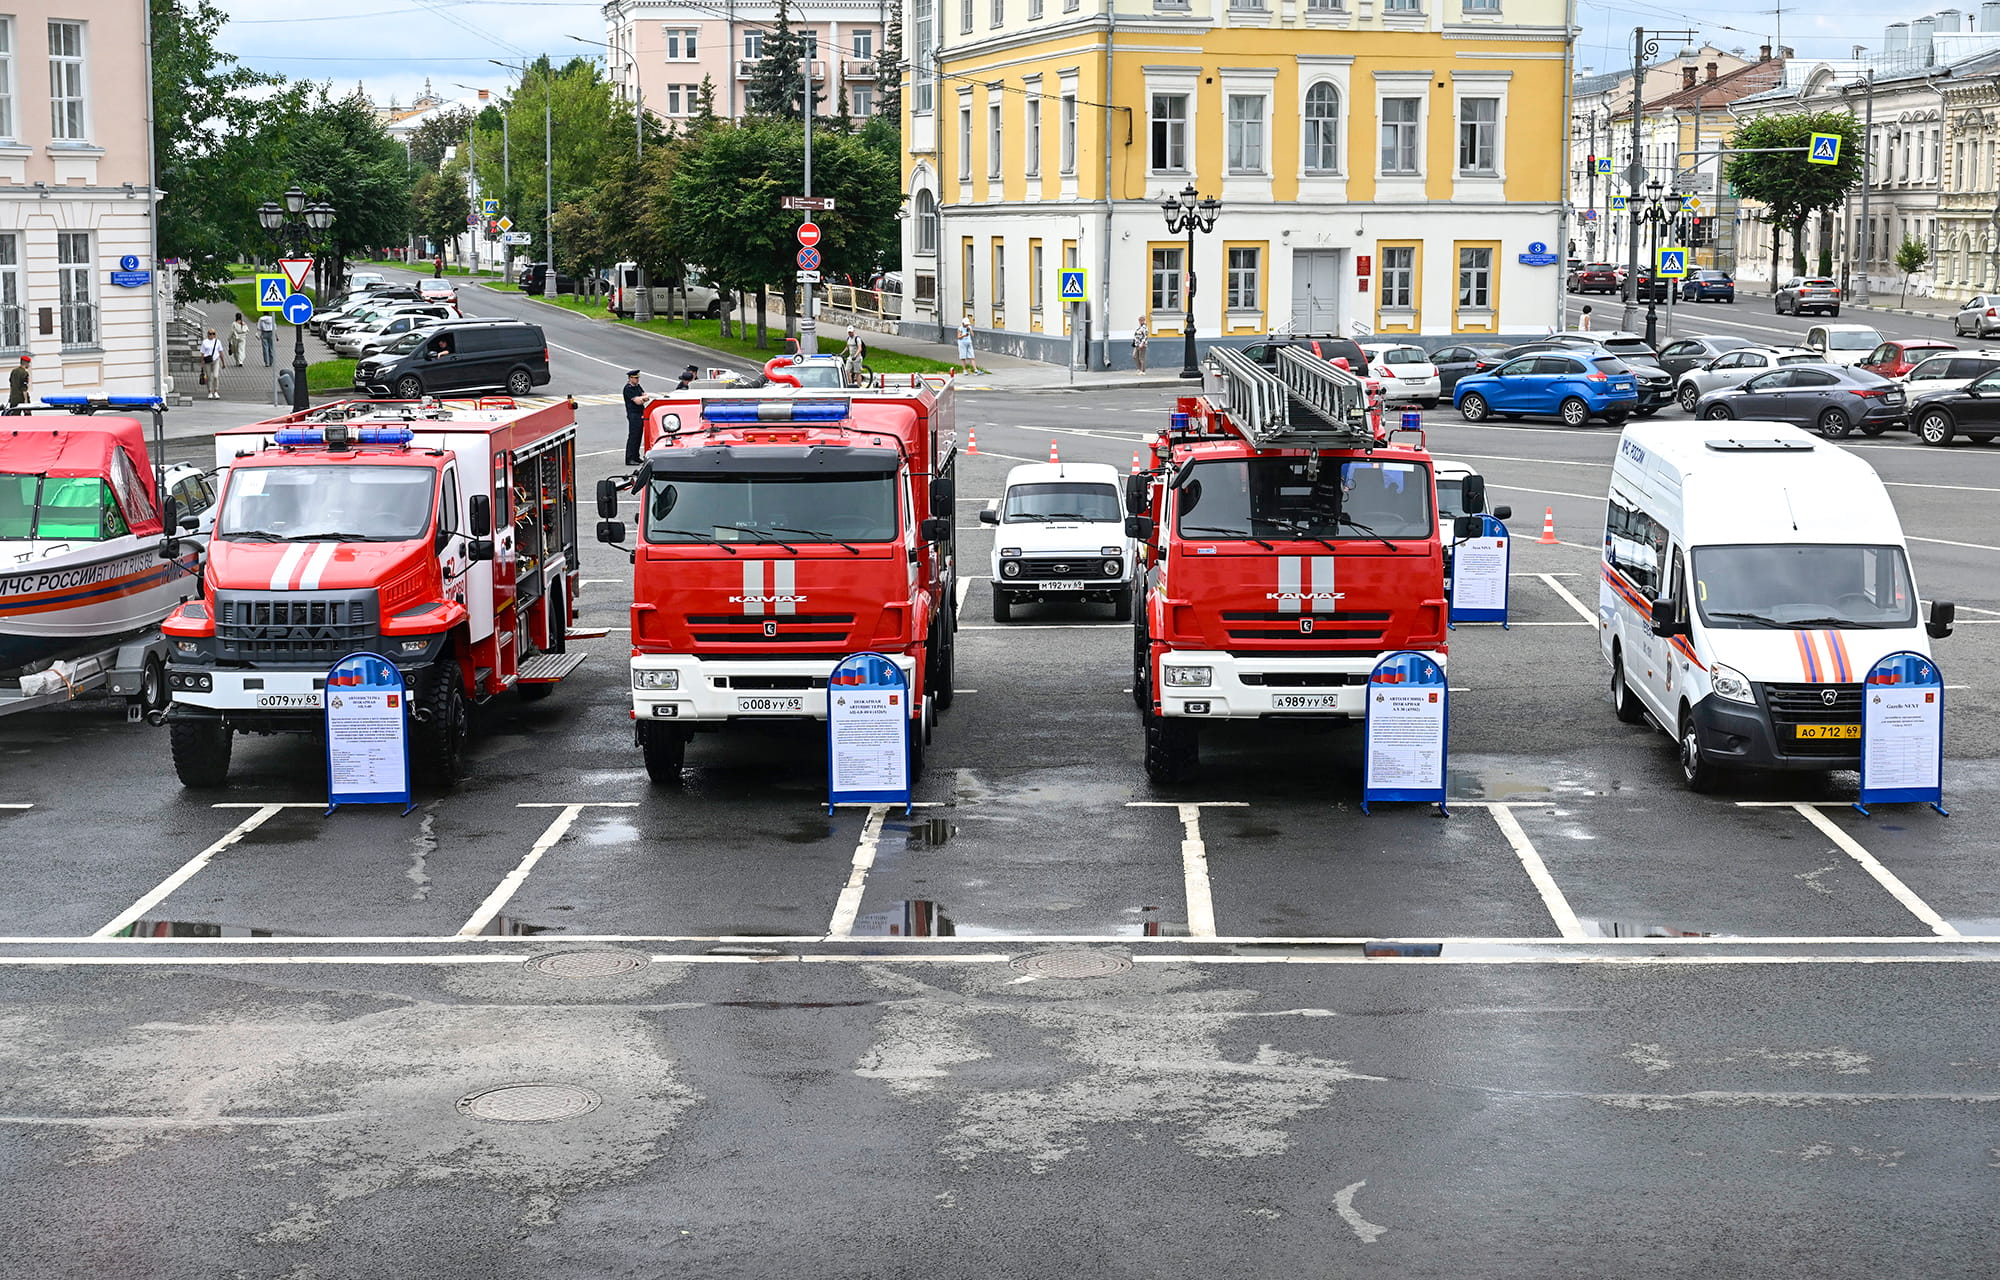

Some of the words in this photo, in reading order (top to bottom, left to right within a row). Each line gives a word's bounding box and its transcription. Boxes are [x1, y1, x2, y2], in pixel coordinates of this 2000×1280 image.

[1535, 244, 1541, 252] 3
[128, 257, 135, 268] 2
[37, 566, 97, 591] РОССИИ
[109, 560, 128, 579] 0117
[728, 595, 808, 603] KAMAZ
[1266, 592, 1345, 600] KAMAZ
[240, 626, 341, 639] УРАЛ
[1820, 726, 1841, 737] 712
[1846, 726, 1858, 735] 69
